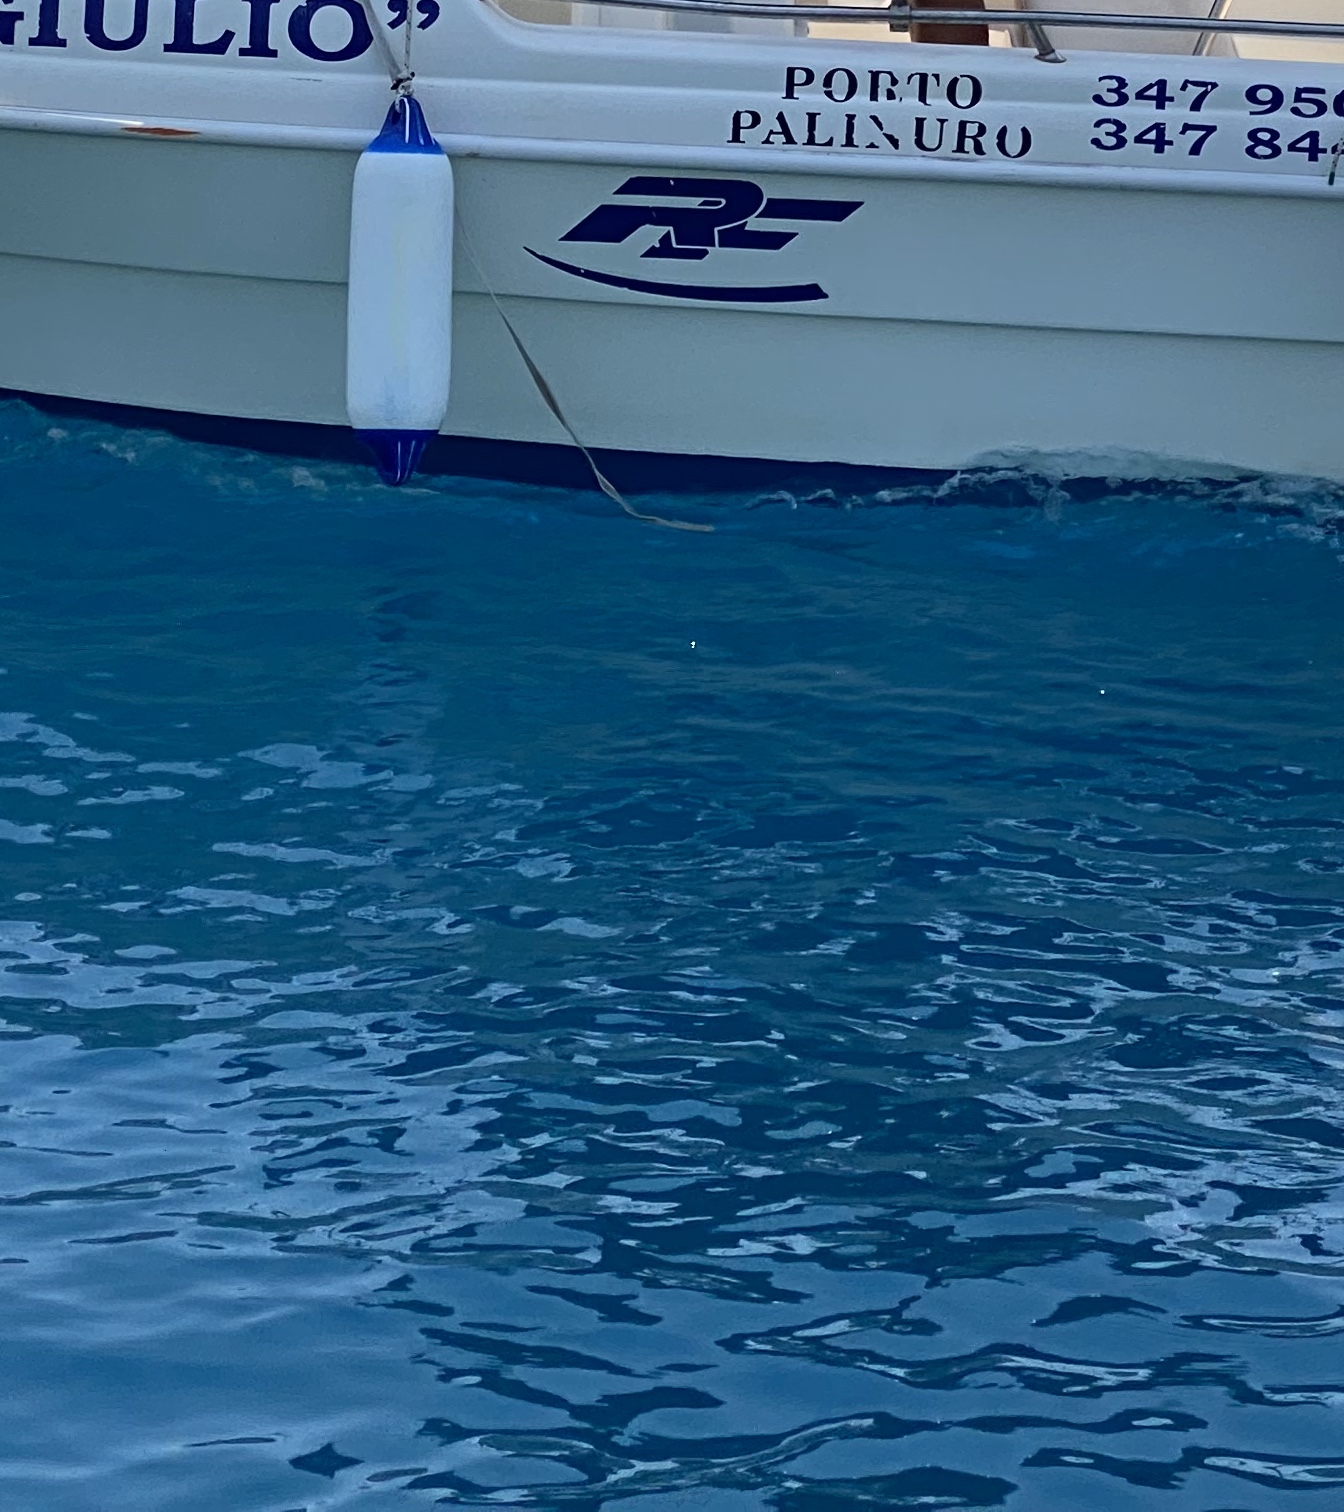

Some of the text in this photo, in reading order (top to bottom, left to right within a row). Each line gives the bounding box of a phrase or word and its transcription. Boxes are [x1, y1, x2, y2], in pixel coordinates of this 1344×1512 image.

[781, 66, 983, 110] PORTO
[1091, 75, 1219, 112] 347
[1090, 117, 1218, 157] 347
